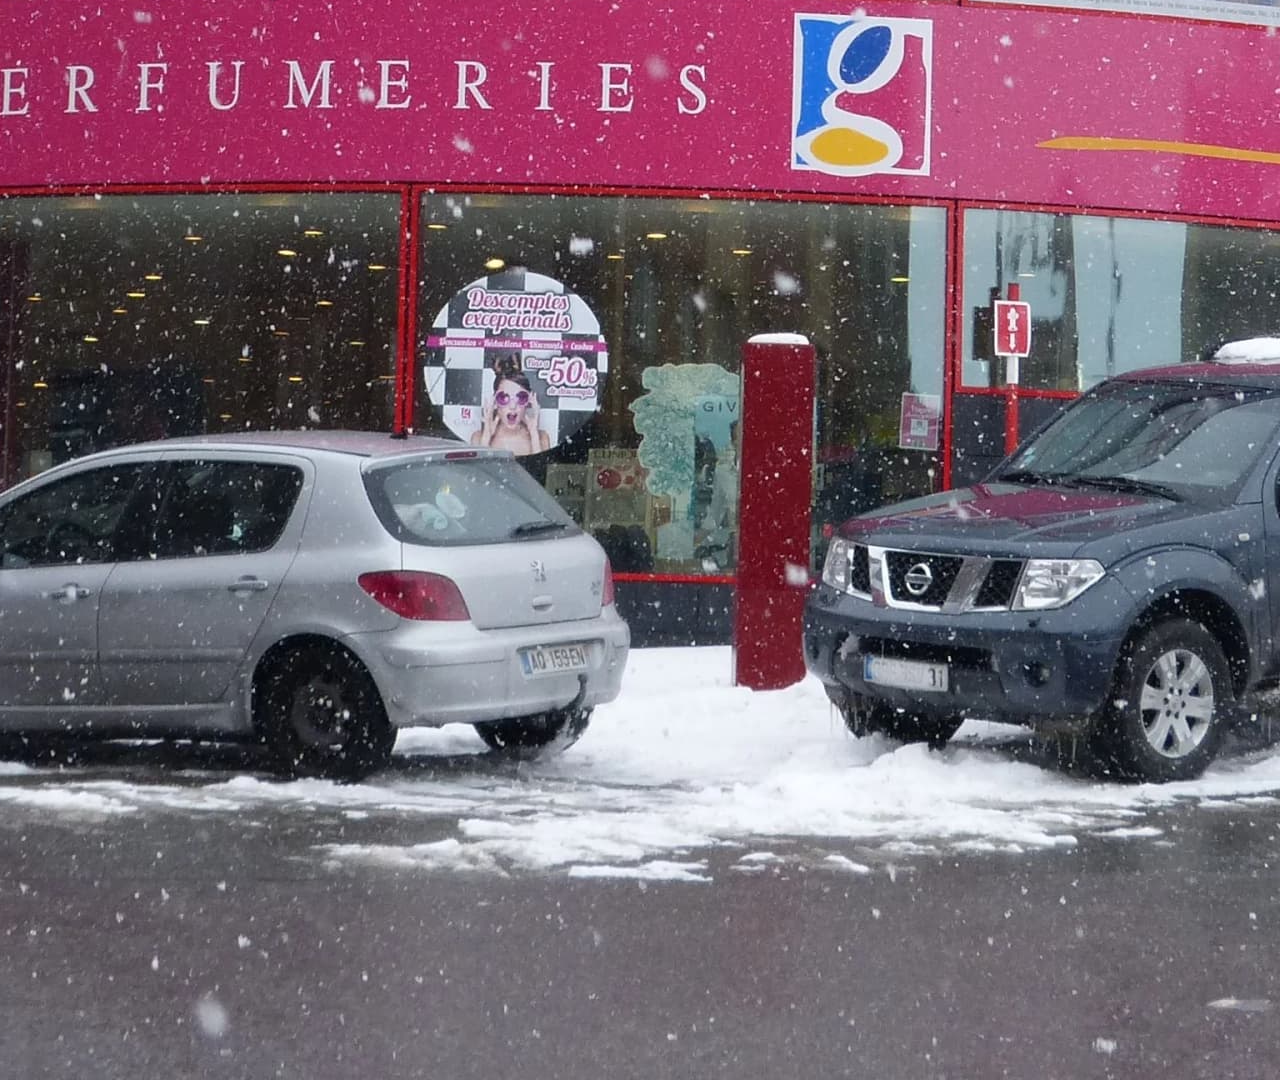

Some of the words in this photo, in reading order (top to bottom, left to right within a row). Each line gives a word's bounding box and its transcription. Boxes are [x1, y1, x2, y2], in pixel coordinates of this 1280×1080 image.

[468, 289, 569, 313] Descomptes
[464, 311, 571, 333] excepcionals
[702, 400, 737, 413] GIV
